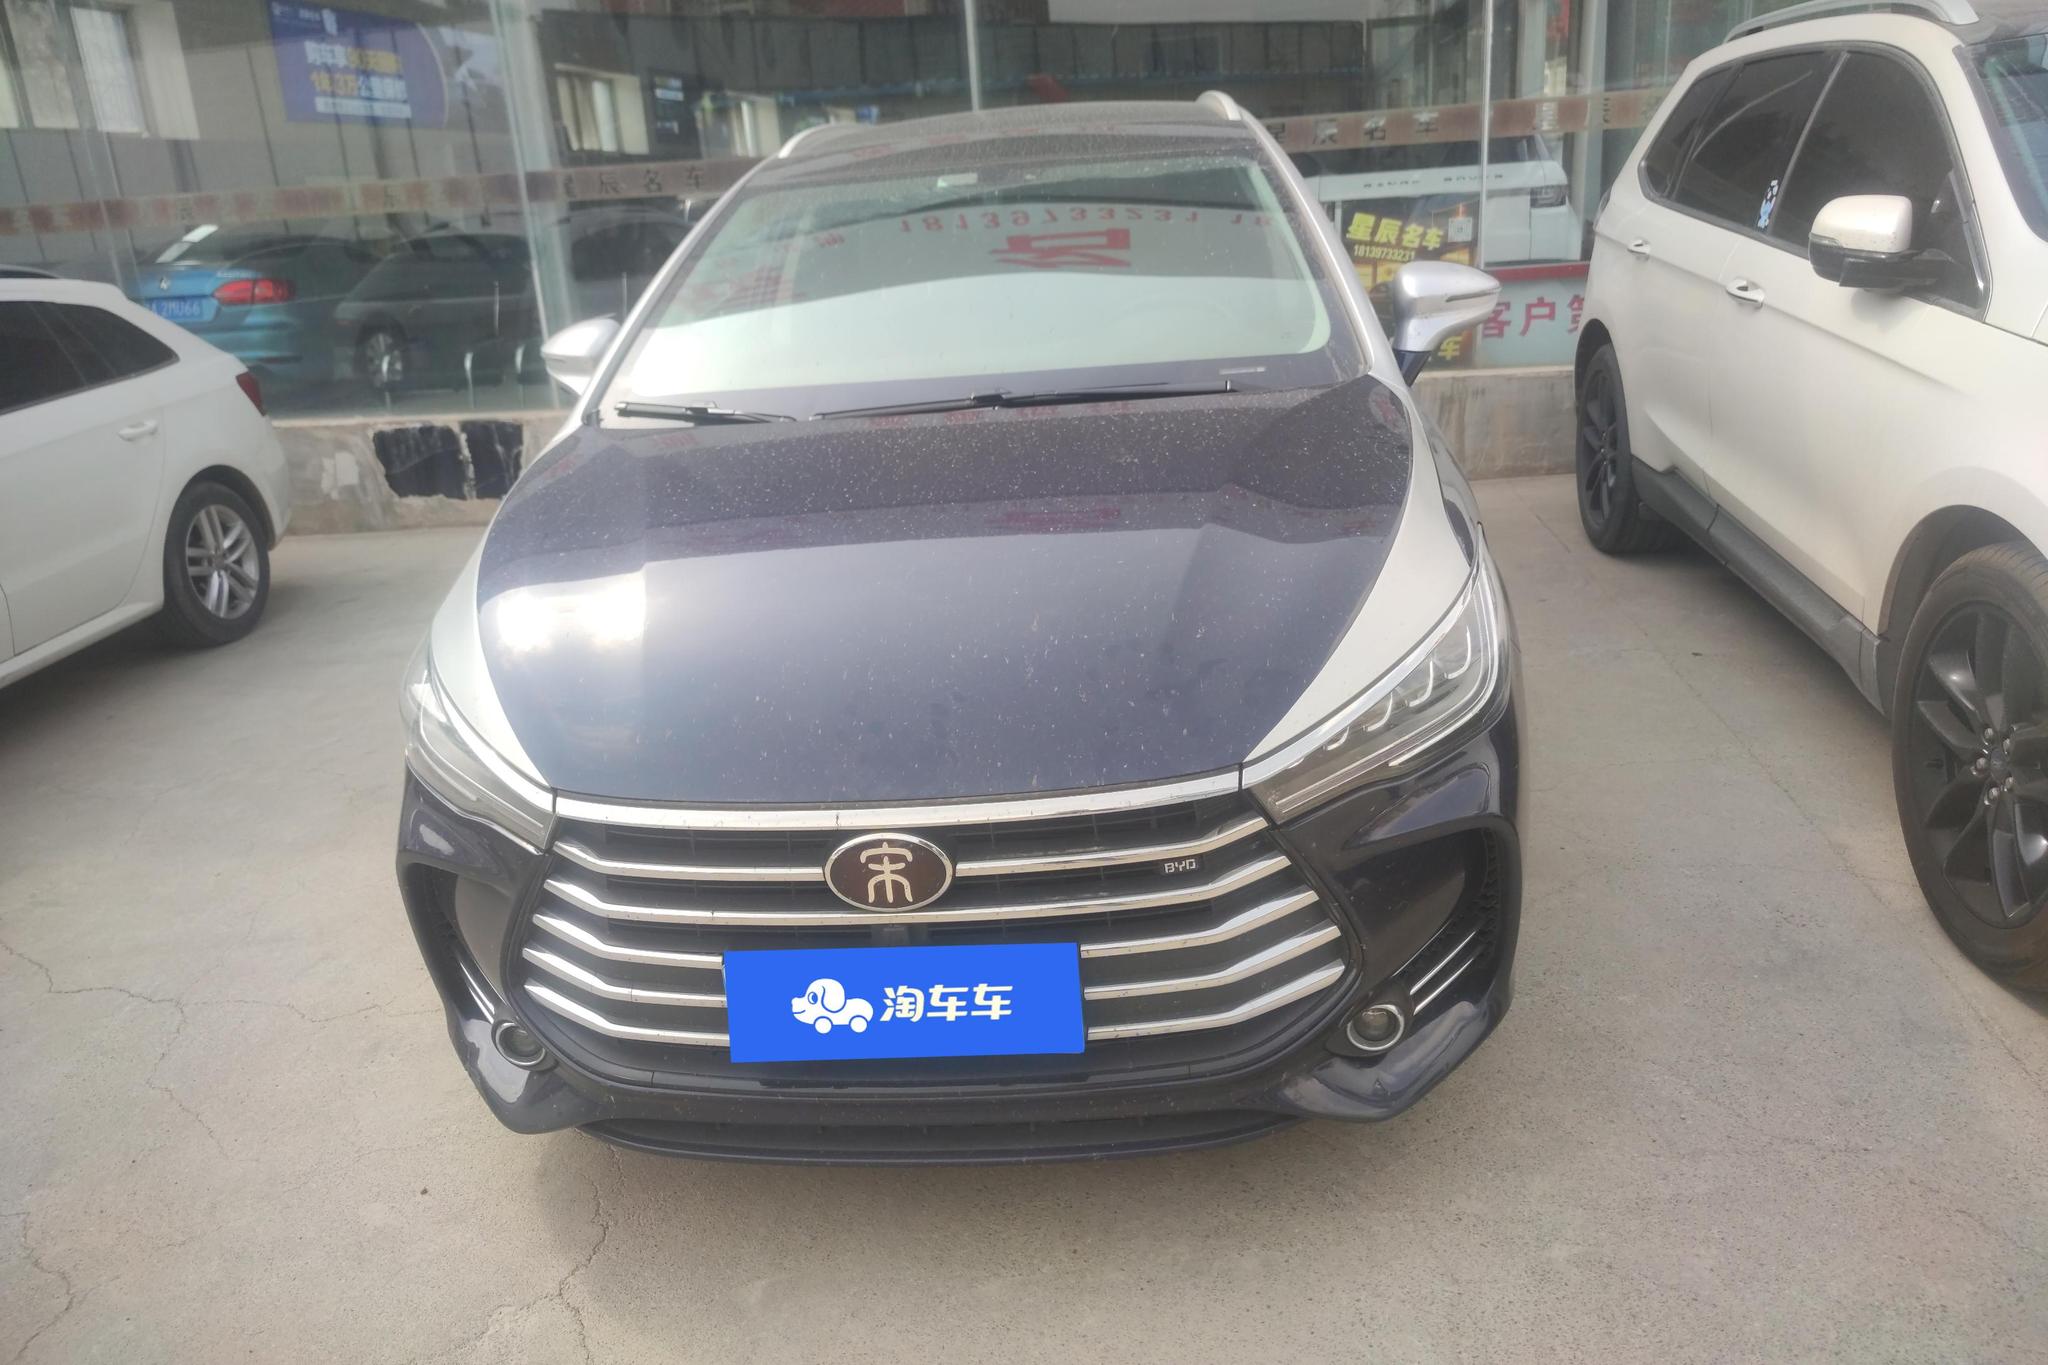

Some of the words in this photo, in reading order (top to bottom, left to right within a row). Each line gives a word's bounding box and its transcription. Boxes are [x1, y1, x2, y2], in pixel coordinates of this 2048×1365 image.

[1346, 212, 1445, 251] 星辰名车
[1354, 244, 1416, 262] 18139733231
[1163, 857, 1197, 875] BYD
